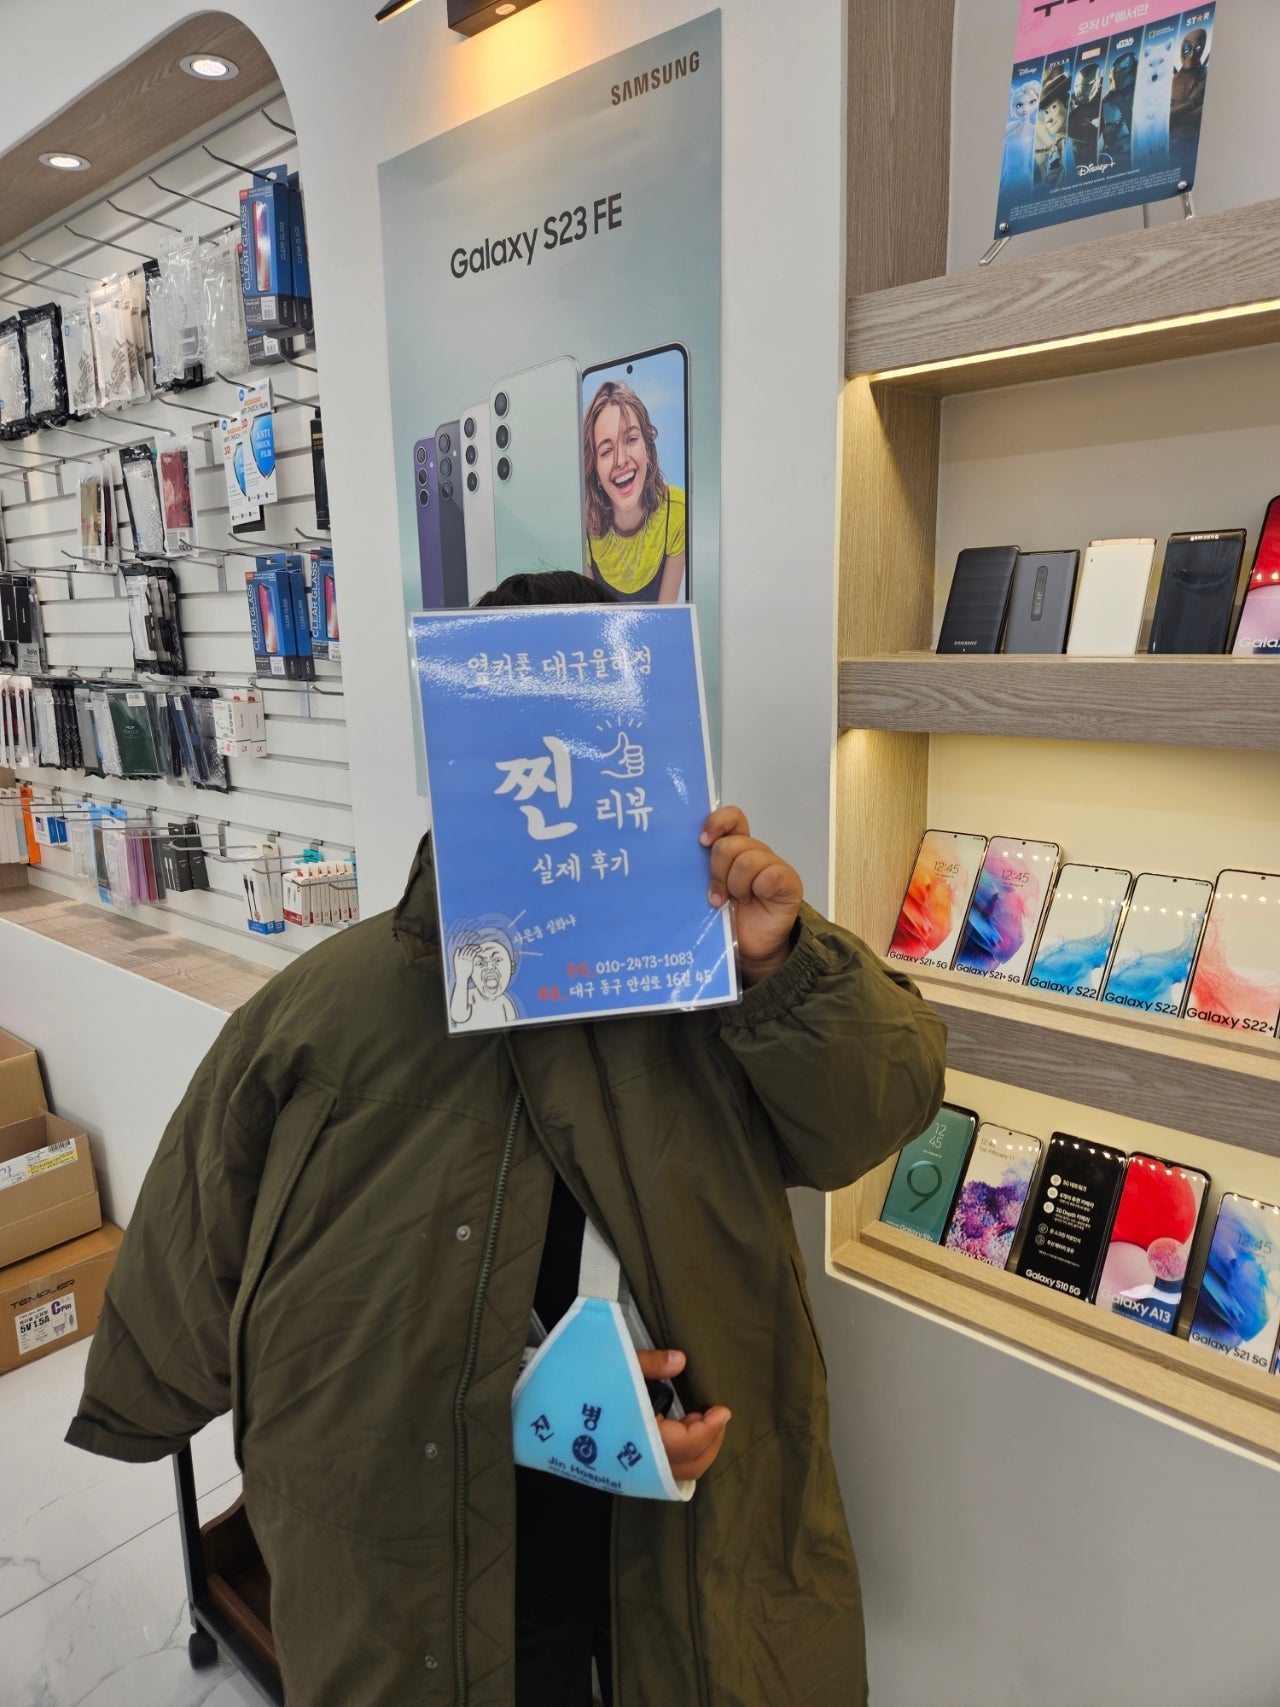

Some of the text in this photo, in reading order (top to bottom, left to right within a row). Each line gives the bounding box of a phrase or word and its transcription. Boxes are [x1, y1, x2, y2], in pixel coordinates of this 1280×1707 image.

[1050, 58, 1070, 69] PIXAR
[611, 51, 700, 107] SAMSUNG
[241, 204, 251, 290] CLEAR GLASS
[450, 192, 622, 279] Galaxy S23 FE
[248, 584, 259, 651] CLEAR GLASS
[311, 600, 319, 638] CLEAR
[493, 736, 578, 840] 찐
[596, 787, 653, 831] 리뷰
[532, 849, 629, 885] 실제 후기
[933, 861, 960, 875] 12:45
[1001, 869, 1030, 884] 12:45
[595, 950, 695, 974] 010-2473-1083
[889, 951, 948, 970] Galaxy S21+ 5G
[956, 963, 1021, 984] Galaxy S21+ 5G
[569, 982, 595, 999] 대구
[600, 978, 622, 996] 동구
[627, 975, 662, 994] 안심로
[1029, 976, 1097, 999] Galaxy S22
[1104, 992, 1178, 1016] Galaxy S22
[1186, 1007, 1275, 1034] Galaxy S22+
[928, 1136, 943, 1149] 45
[934, 1122, 948, 1137] 12
[1237, 1231, 1273, 1254] 12:45
[1025, 1268, 1081, 1296] Galaxy S10 5G
[1102, 1289, 1150, 1317] Galaxy
[1149, 1307, 1171, 1324] A13
[1191, 1332, 1268, 1368] Galaxy S21 5G
[548, 1457, 566, 1469] Jin
[571, 1464, 622, 1488] Hospital
